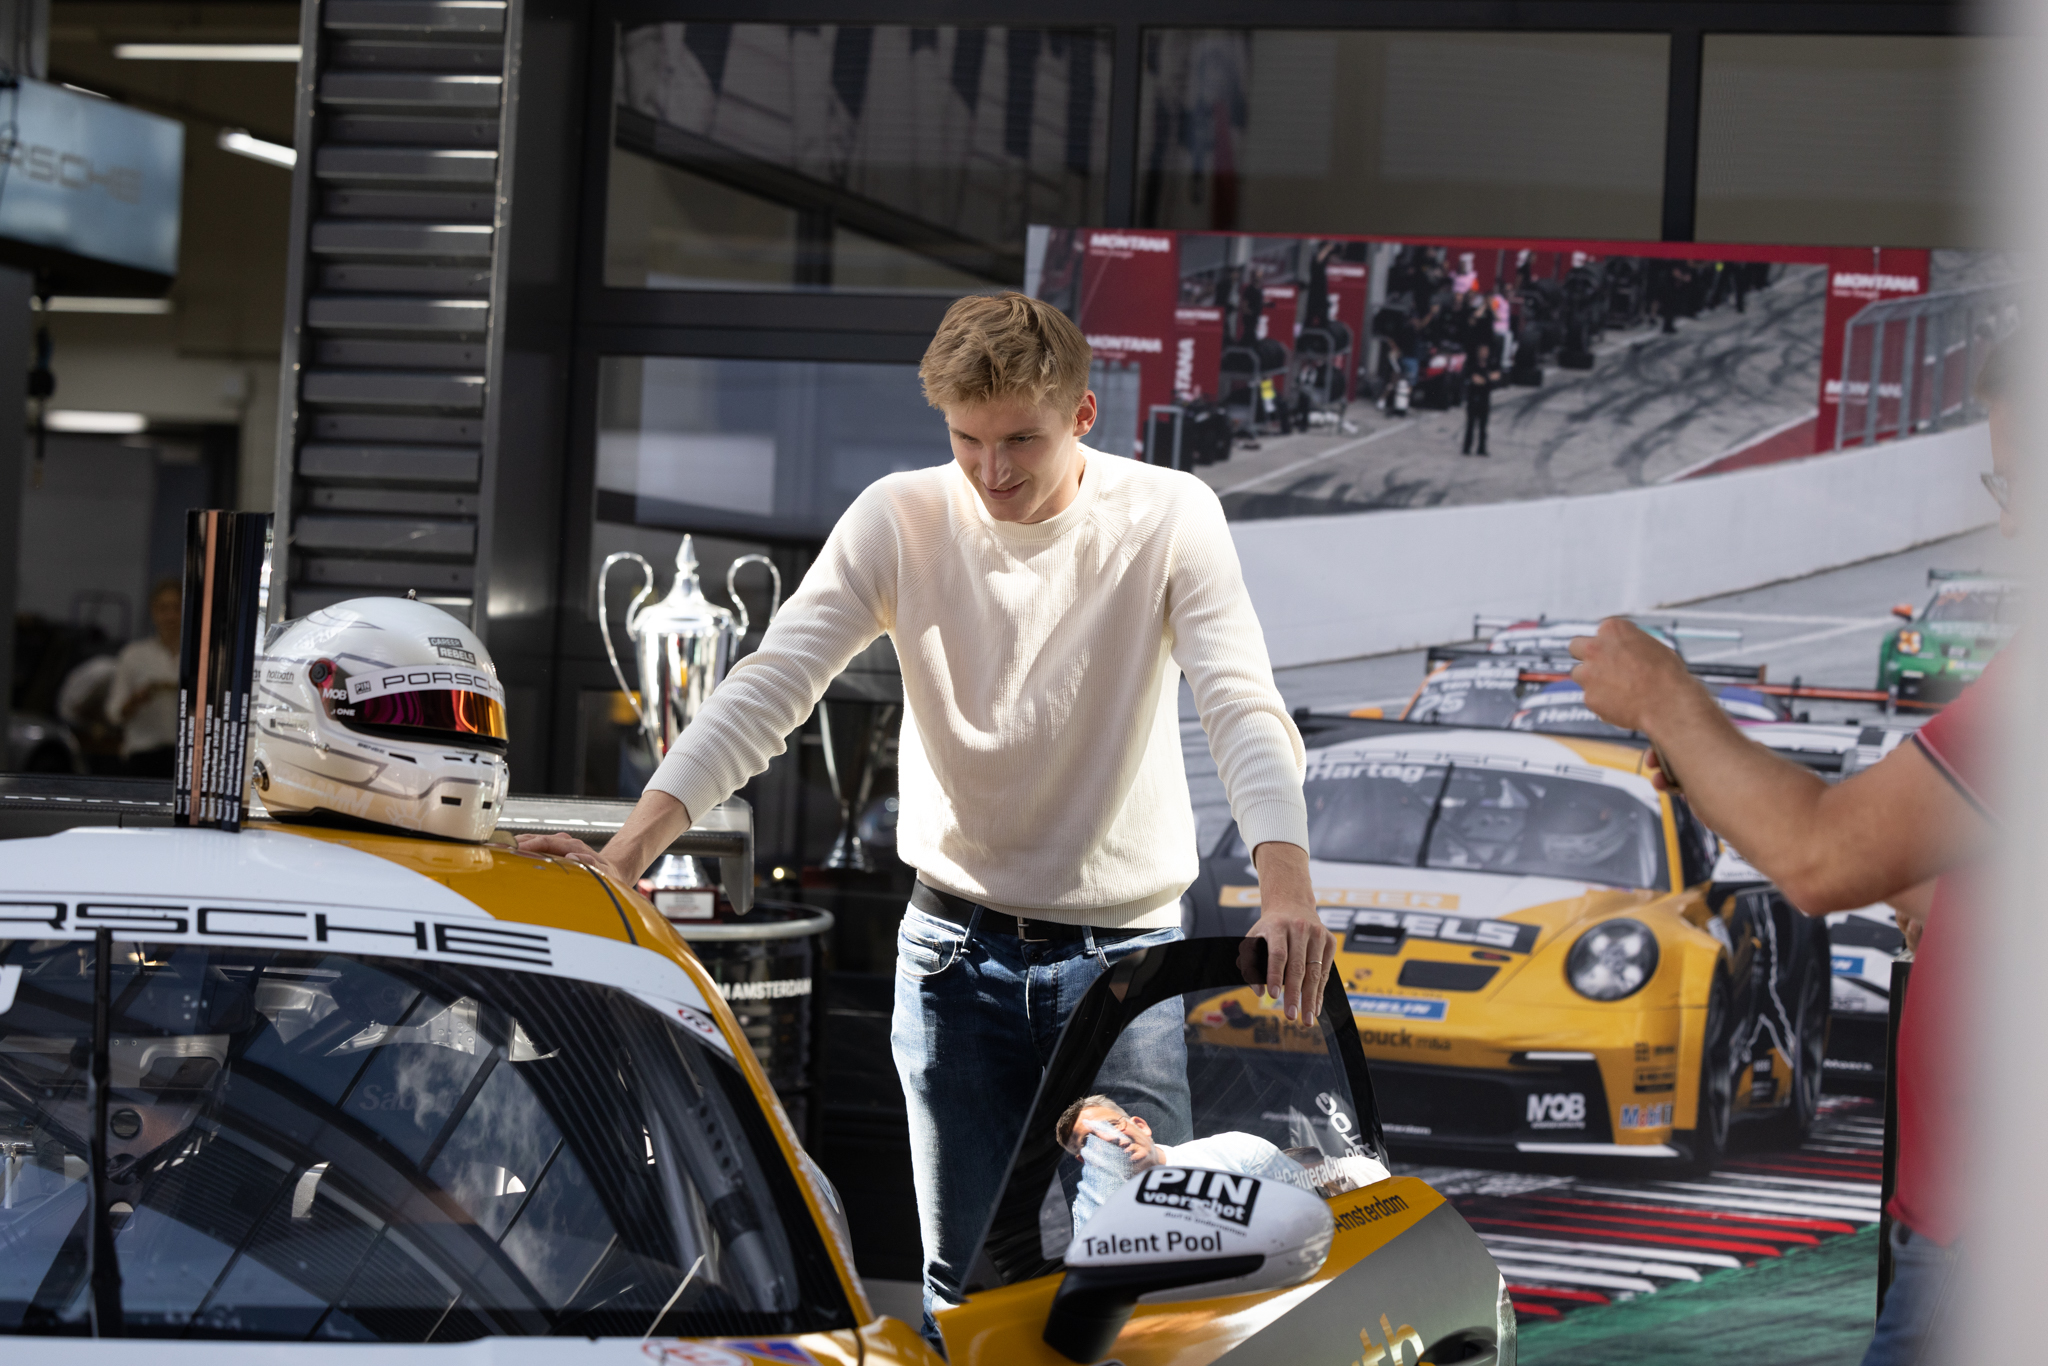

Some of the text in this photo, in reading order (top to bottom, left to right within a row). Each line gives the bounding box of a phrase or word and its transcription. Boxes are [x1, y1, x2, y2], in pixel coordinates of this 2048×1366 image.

[430, 637, 462, 647] CAREER
[440, 647, 475, 662] REBELS
[1307, 761, 1426, 784] Hartog
[1237, 886, 1446, 910] CREER
[1320, 906, 1521, 949] EBELS
[732, 978, 813, 1000] AMSTERDAM
[1526, 1092, 1587, 1123] MOB
[1144, 1168, 1254, 1206] PIN
[1334, 1193, 1410, 1234] Amsterdam
[1083, 1230, 1223, 1258] Talent Pool
